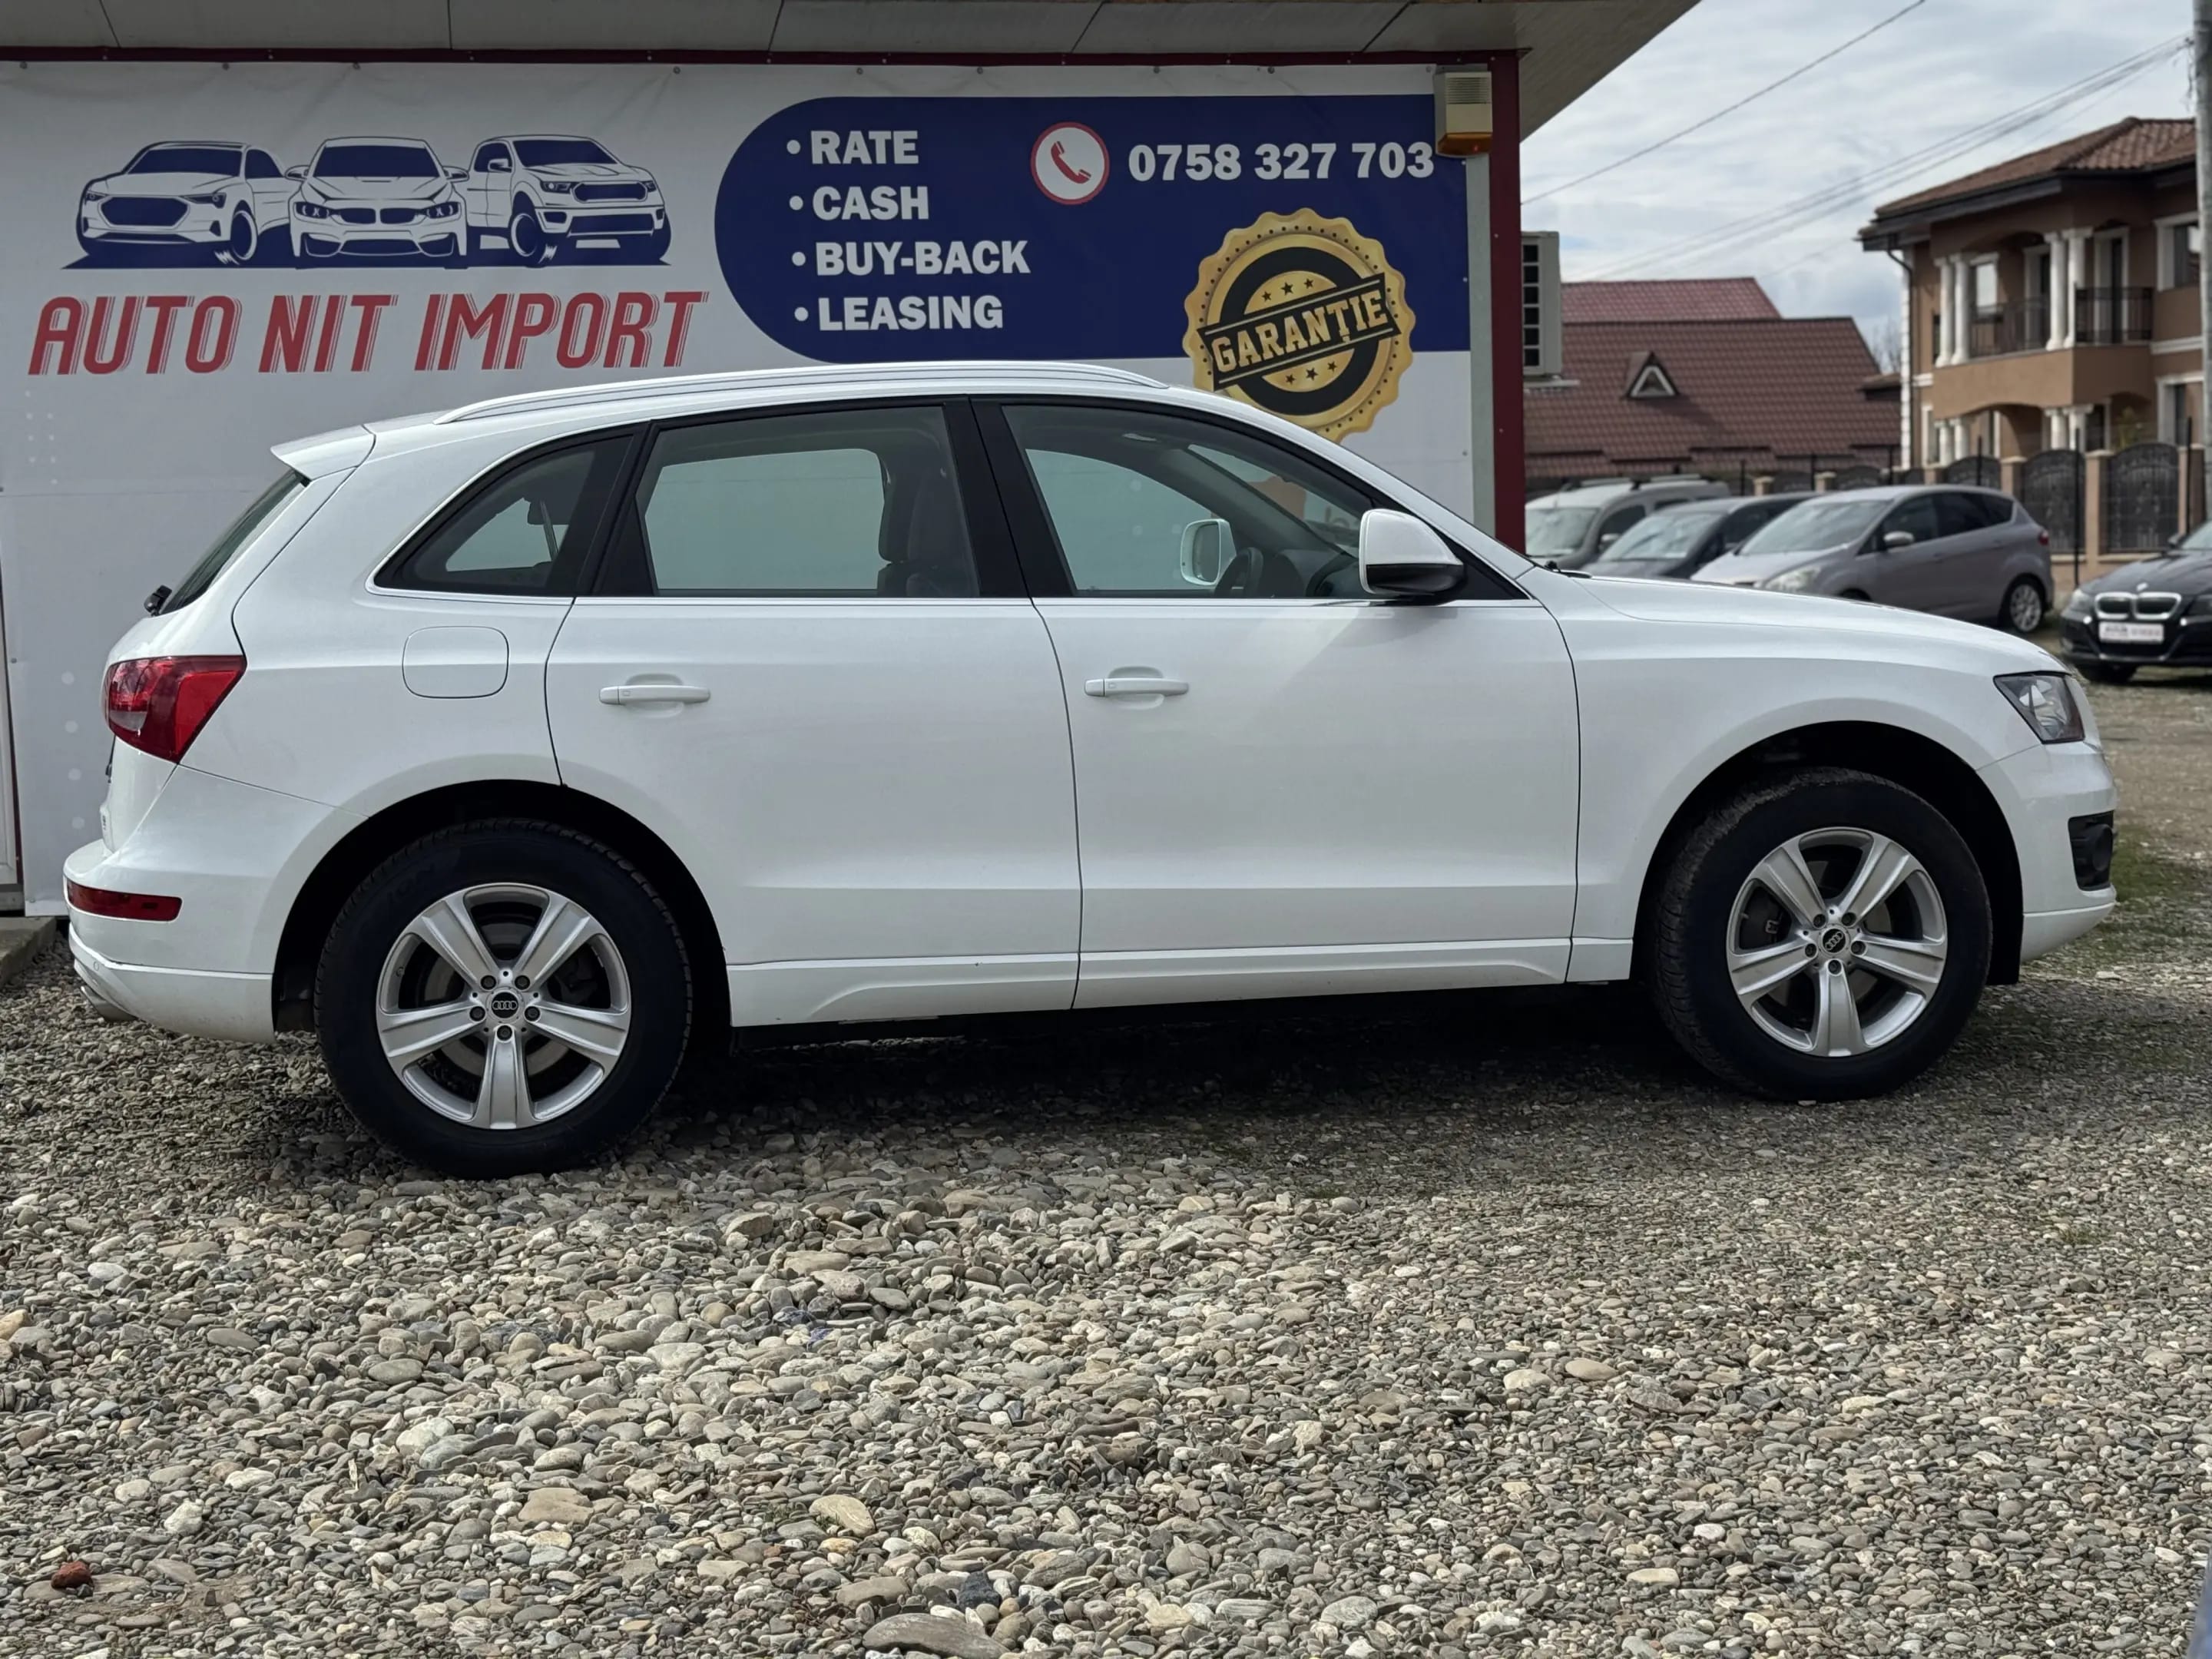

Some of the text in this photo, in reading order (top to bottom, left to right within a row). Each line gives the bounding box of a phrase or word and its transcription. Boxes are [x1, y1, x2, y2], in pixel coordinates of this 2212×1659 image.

[810, 130, 919, 164] RATE
[1128, 141, 1434, 181] 0758 327 703
[812, 185, 929, 221] CASH
[816, 240, 1031, 276] BUY-BACK
[818, 294, 1003, 331] LEASING
[28, 290, 709, 376] AUTO NIT IMPORT
